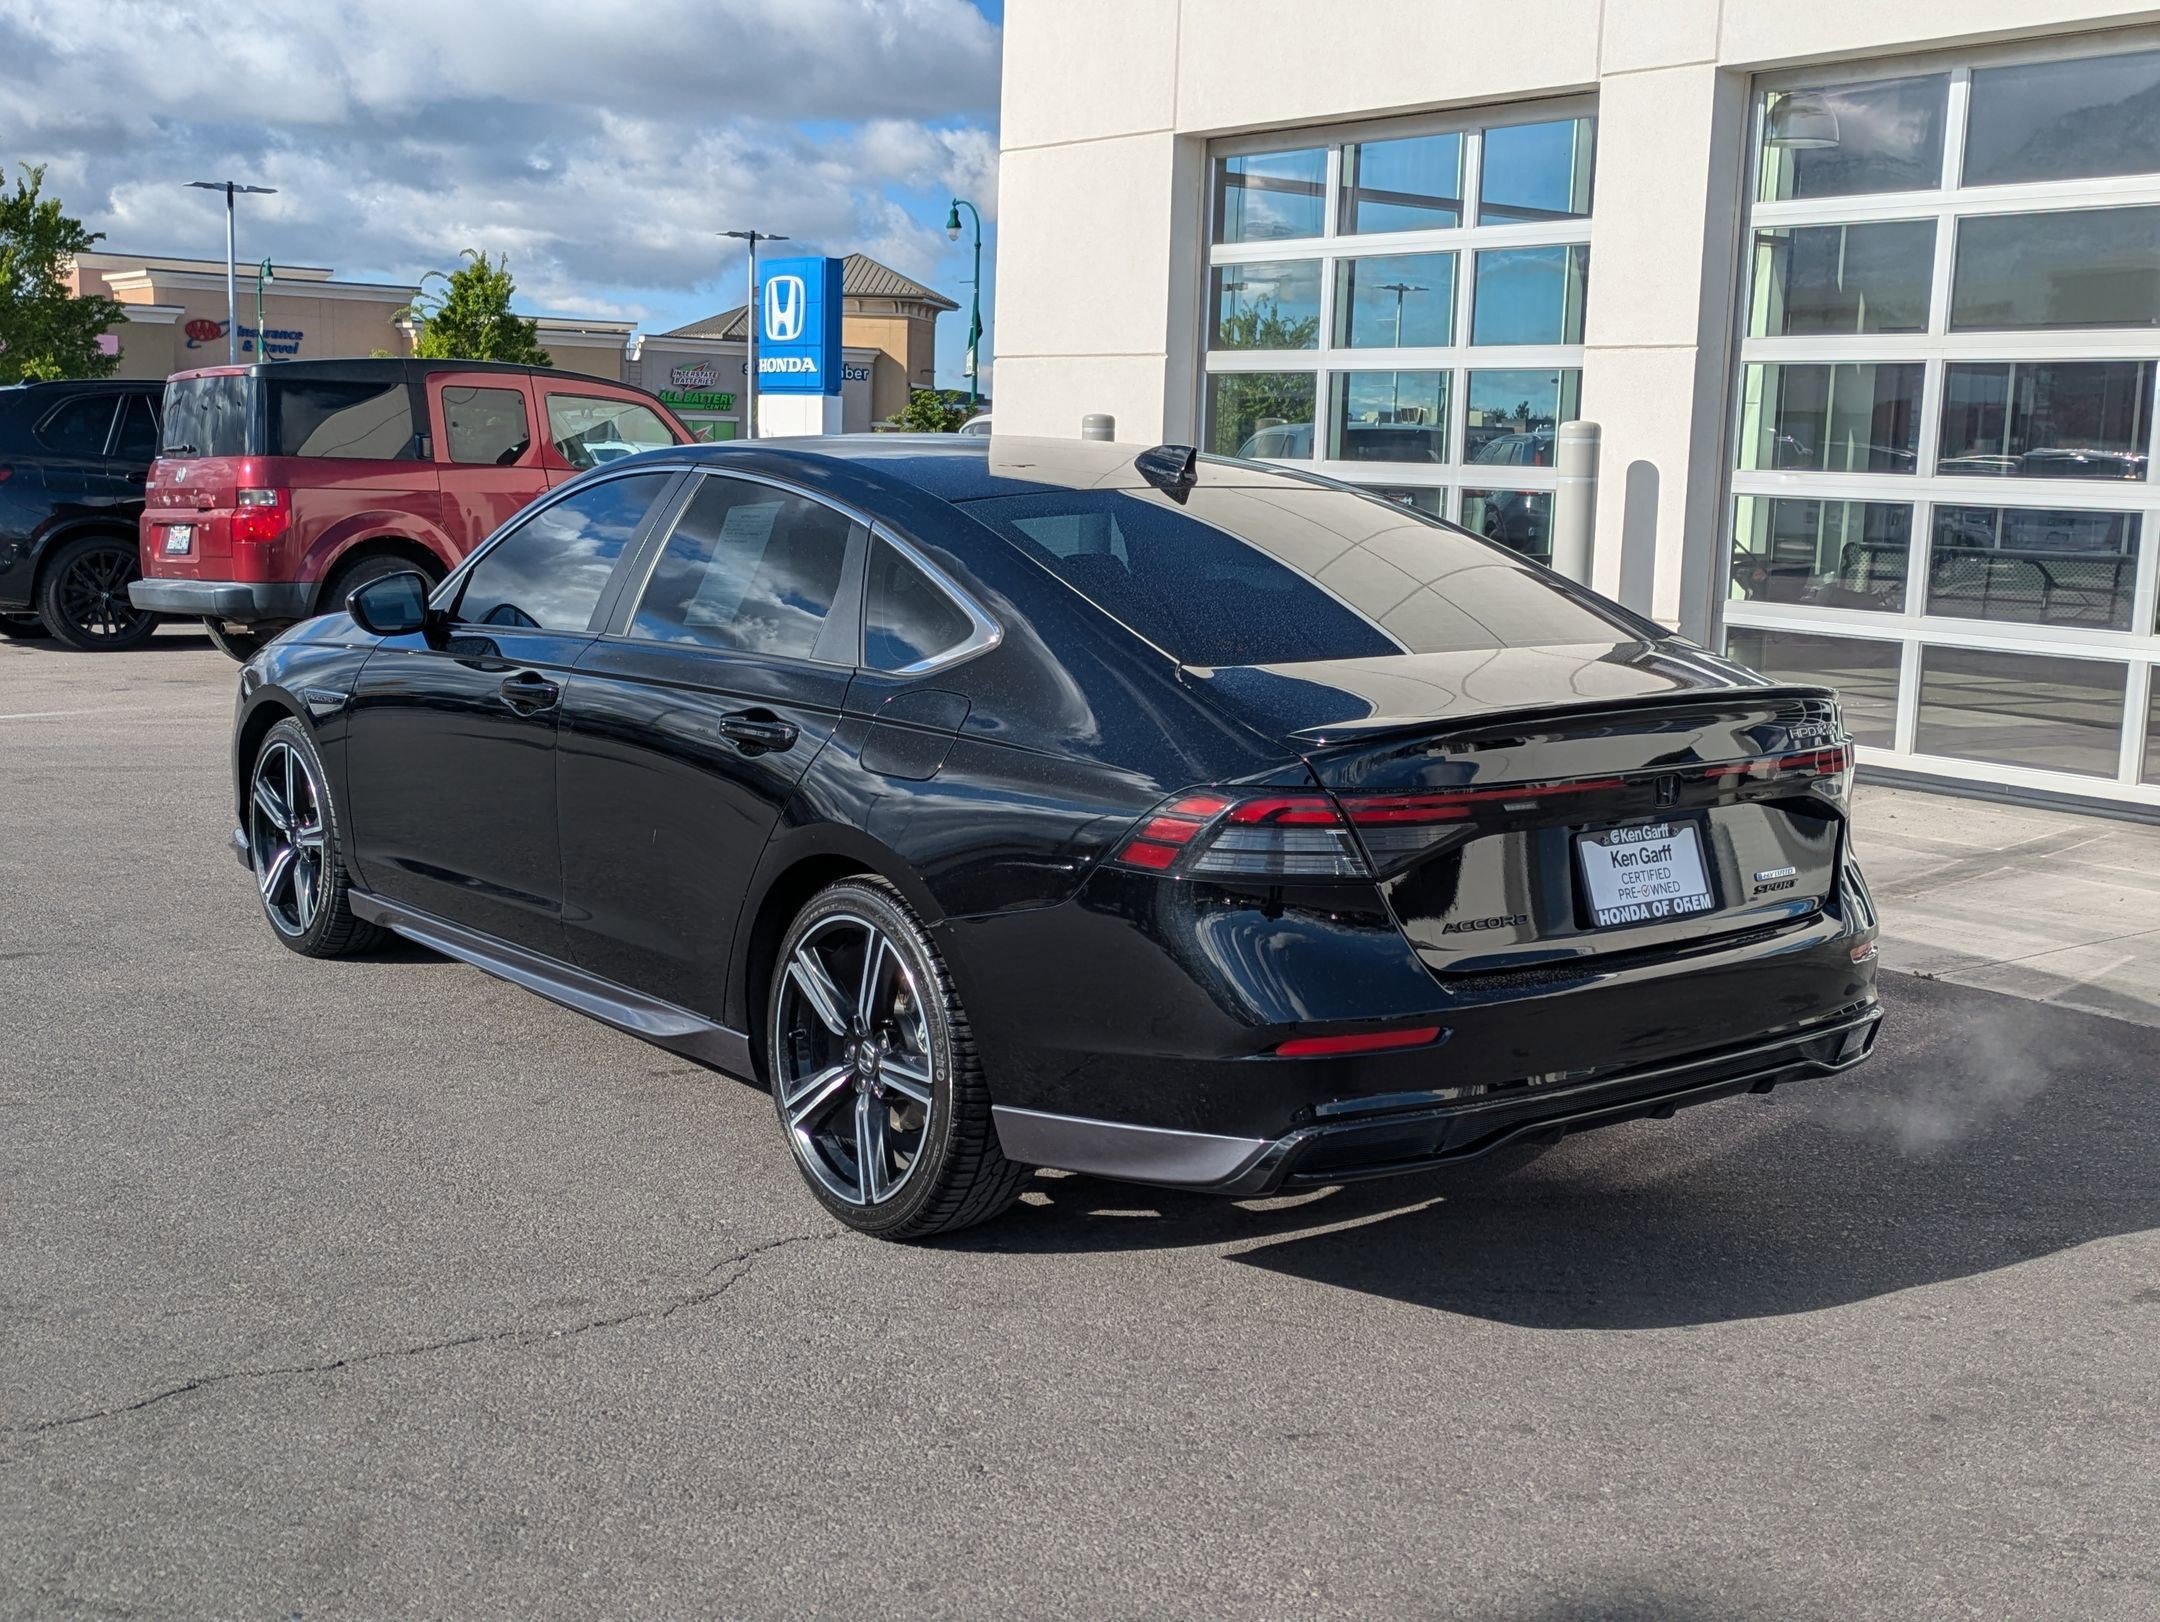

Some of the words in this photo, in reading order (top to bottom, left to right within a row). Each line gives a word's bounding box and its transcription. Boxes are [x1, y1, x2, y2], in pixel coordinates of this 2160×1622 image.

[242, 340, 253, 352] &
[262, 342, 300, 354] ravel
[672, 368, 719, 379] INTERSTATE
[758, 357, 818, 373] HONDA
[842, 363, 870, 381] ber
[673, 376, 716, 387] BATTERIES
[660, 391, 681, 401] ALL
[683, 391, 736, 404] BATTERY
[1619, 829, 1642, 843] Ken
[1642, 823, 1670, 841] Garff
[1610, 850, 1639, 868] Ken
[1639, 844, 1672, 865] Garff
[1621, 867, 1672, 885] CERTIFIED
[1763, 868, 1793, 879] HYBRID
[1618, 881, 1681, 900] PRE-OWNED
[1753, 878, 1799, 895] SPORT
[1598, 906, 1651, 926] HONDA
[1652, 900, 1670, 917] OF
[1673, 893, 1712, 914] OREM
[1441, 914, 1529, 935] ACCORD
